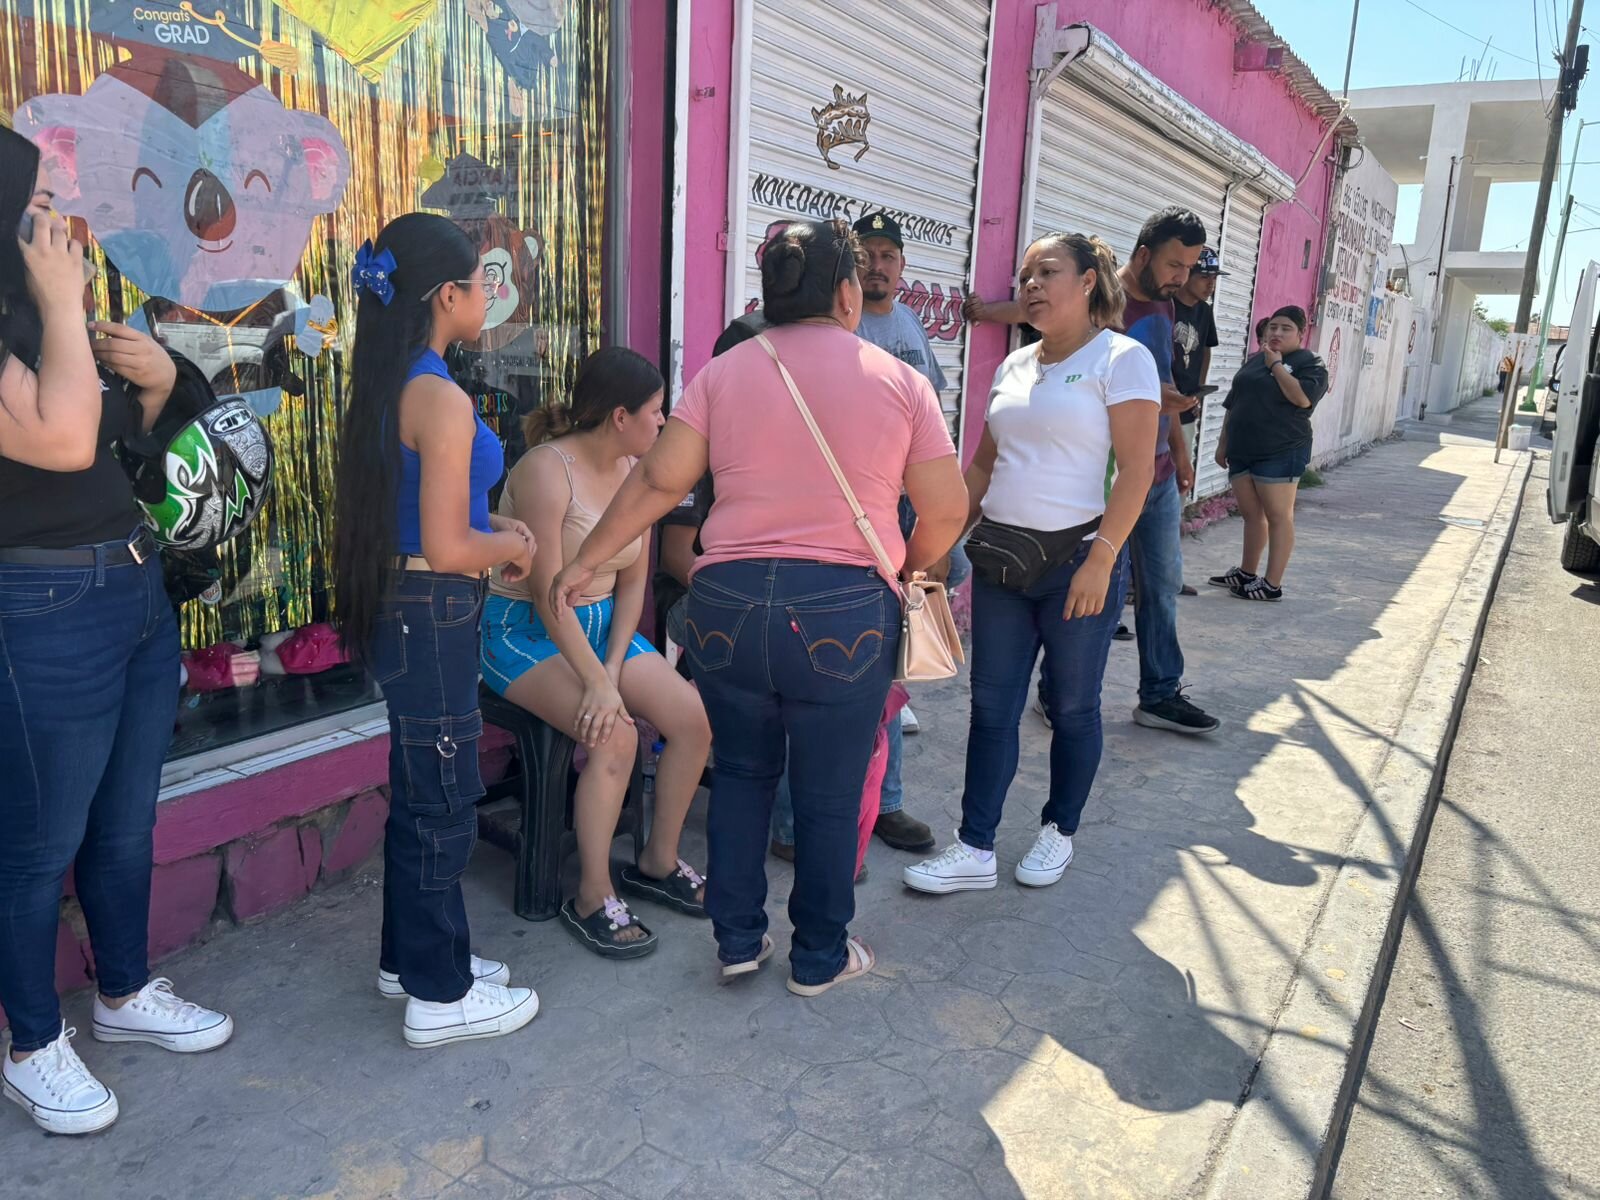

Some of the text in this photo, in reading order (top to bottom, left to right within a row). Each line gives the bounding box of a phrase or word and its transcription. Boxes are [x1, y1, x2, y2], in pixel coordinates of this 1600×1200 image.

[133, 7, 191, 24] Congrats
[154, 23, 210, 45] GRAD
[751, 173, 857, 226] NOVEDADES
[880, 206, 957, 246] ESORIOS
[470, 393, 508, 414] NGRATS
[219, 410, 250, 431] HJC
